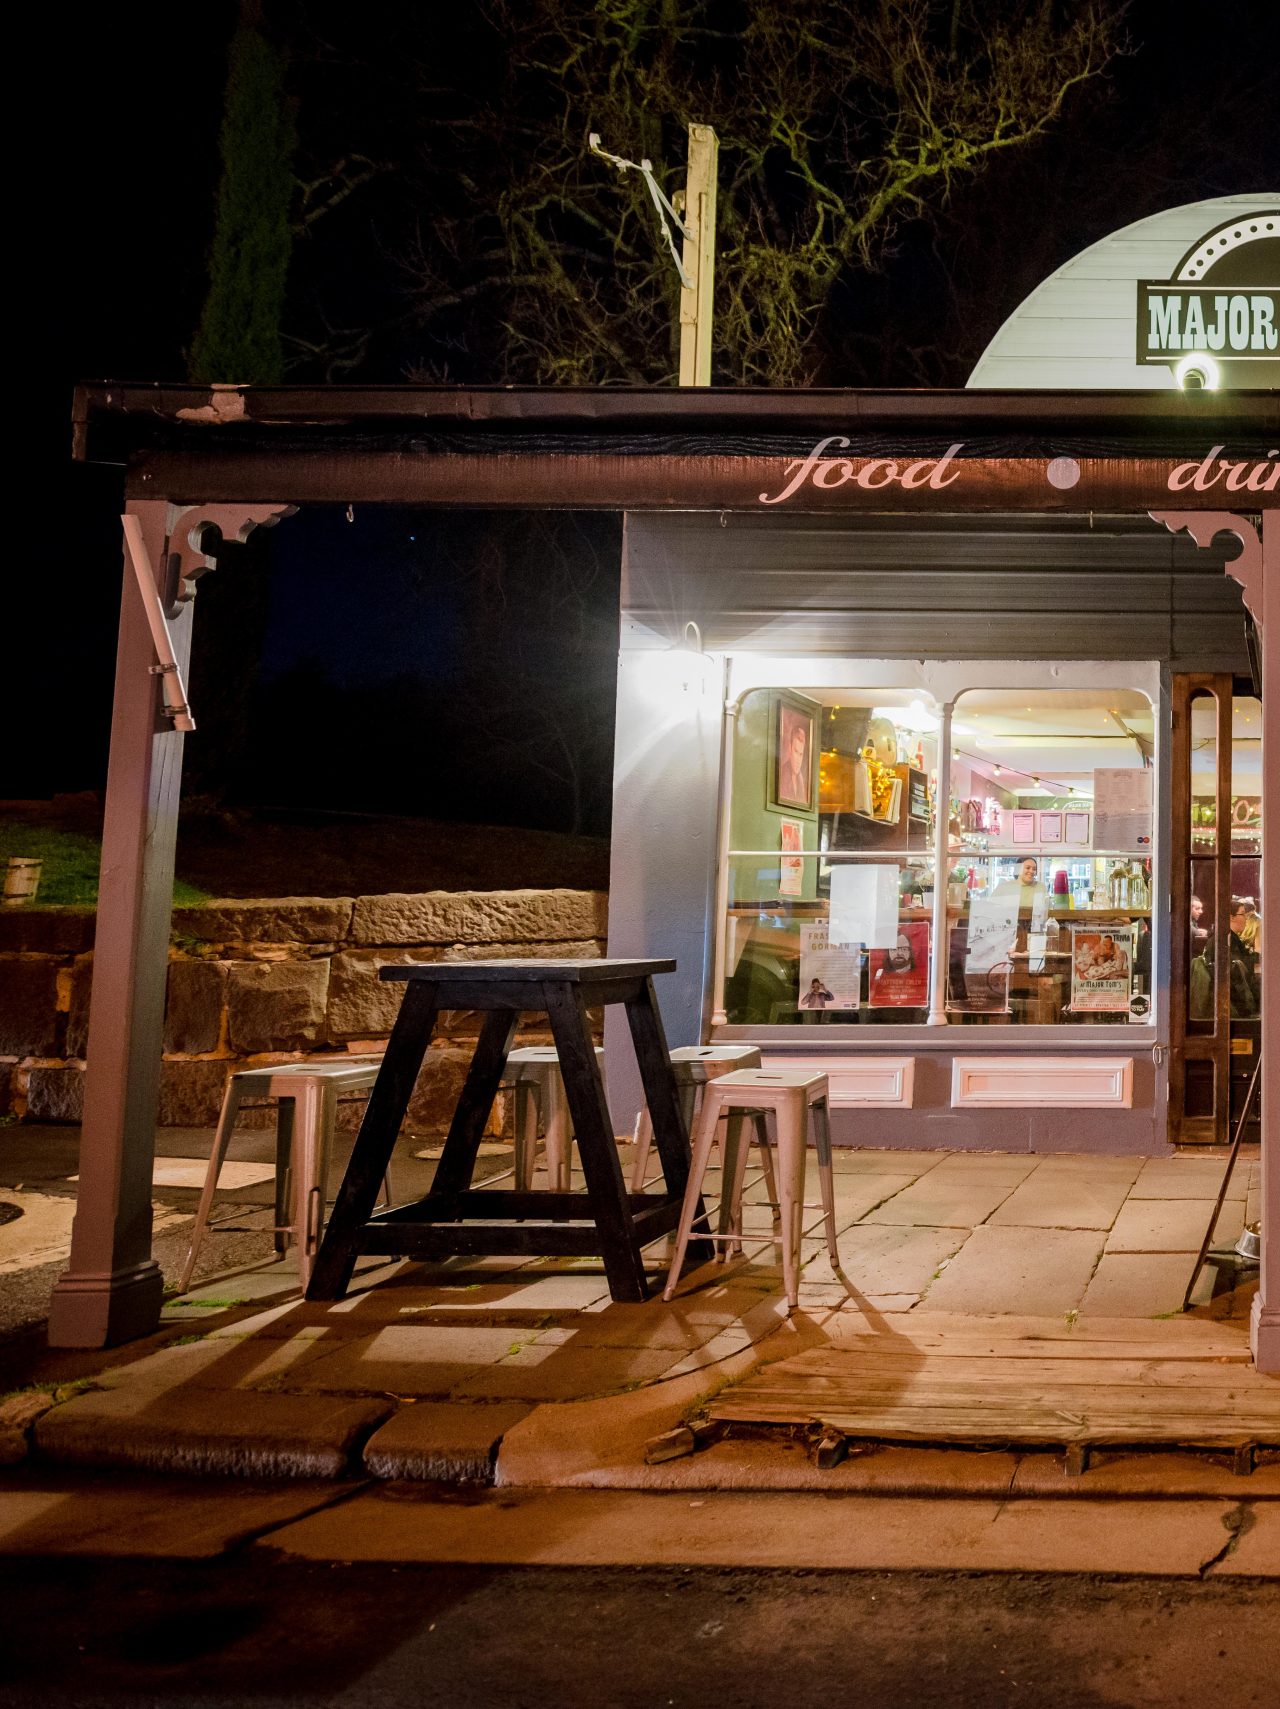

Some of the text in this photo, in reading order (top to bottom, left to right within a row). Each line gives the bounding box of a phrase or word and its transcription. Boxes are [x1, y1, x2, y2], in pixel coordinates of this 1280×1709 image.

[1147, 295, 1279, 351] MAJOR
[759, 436, 965, 504] food
[1086, 980, 1104, 989] MAJOR
